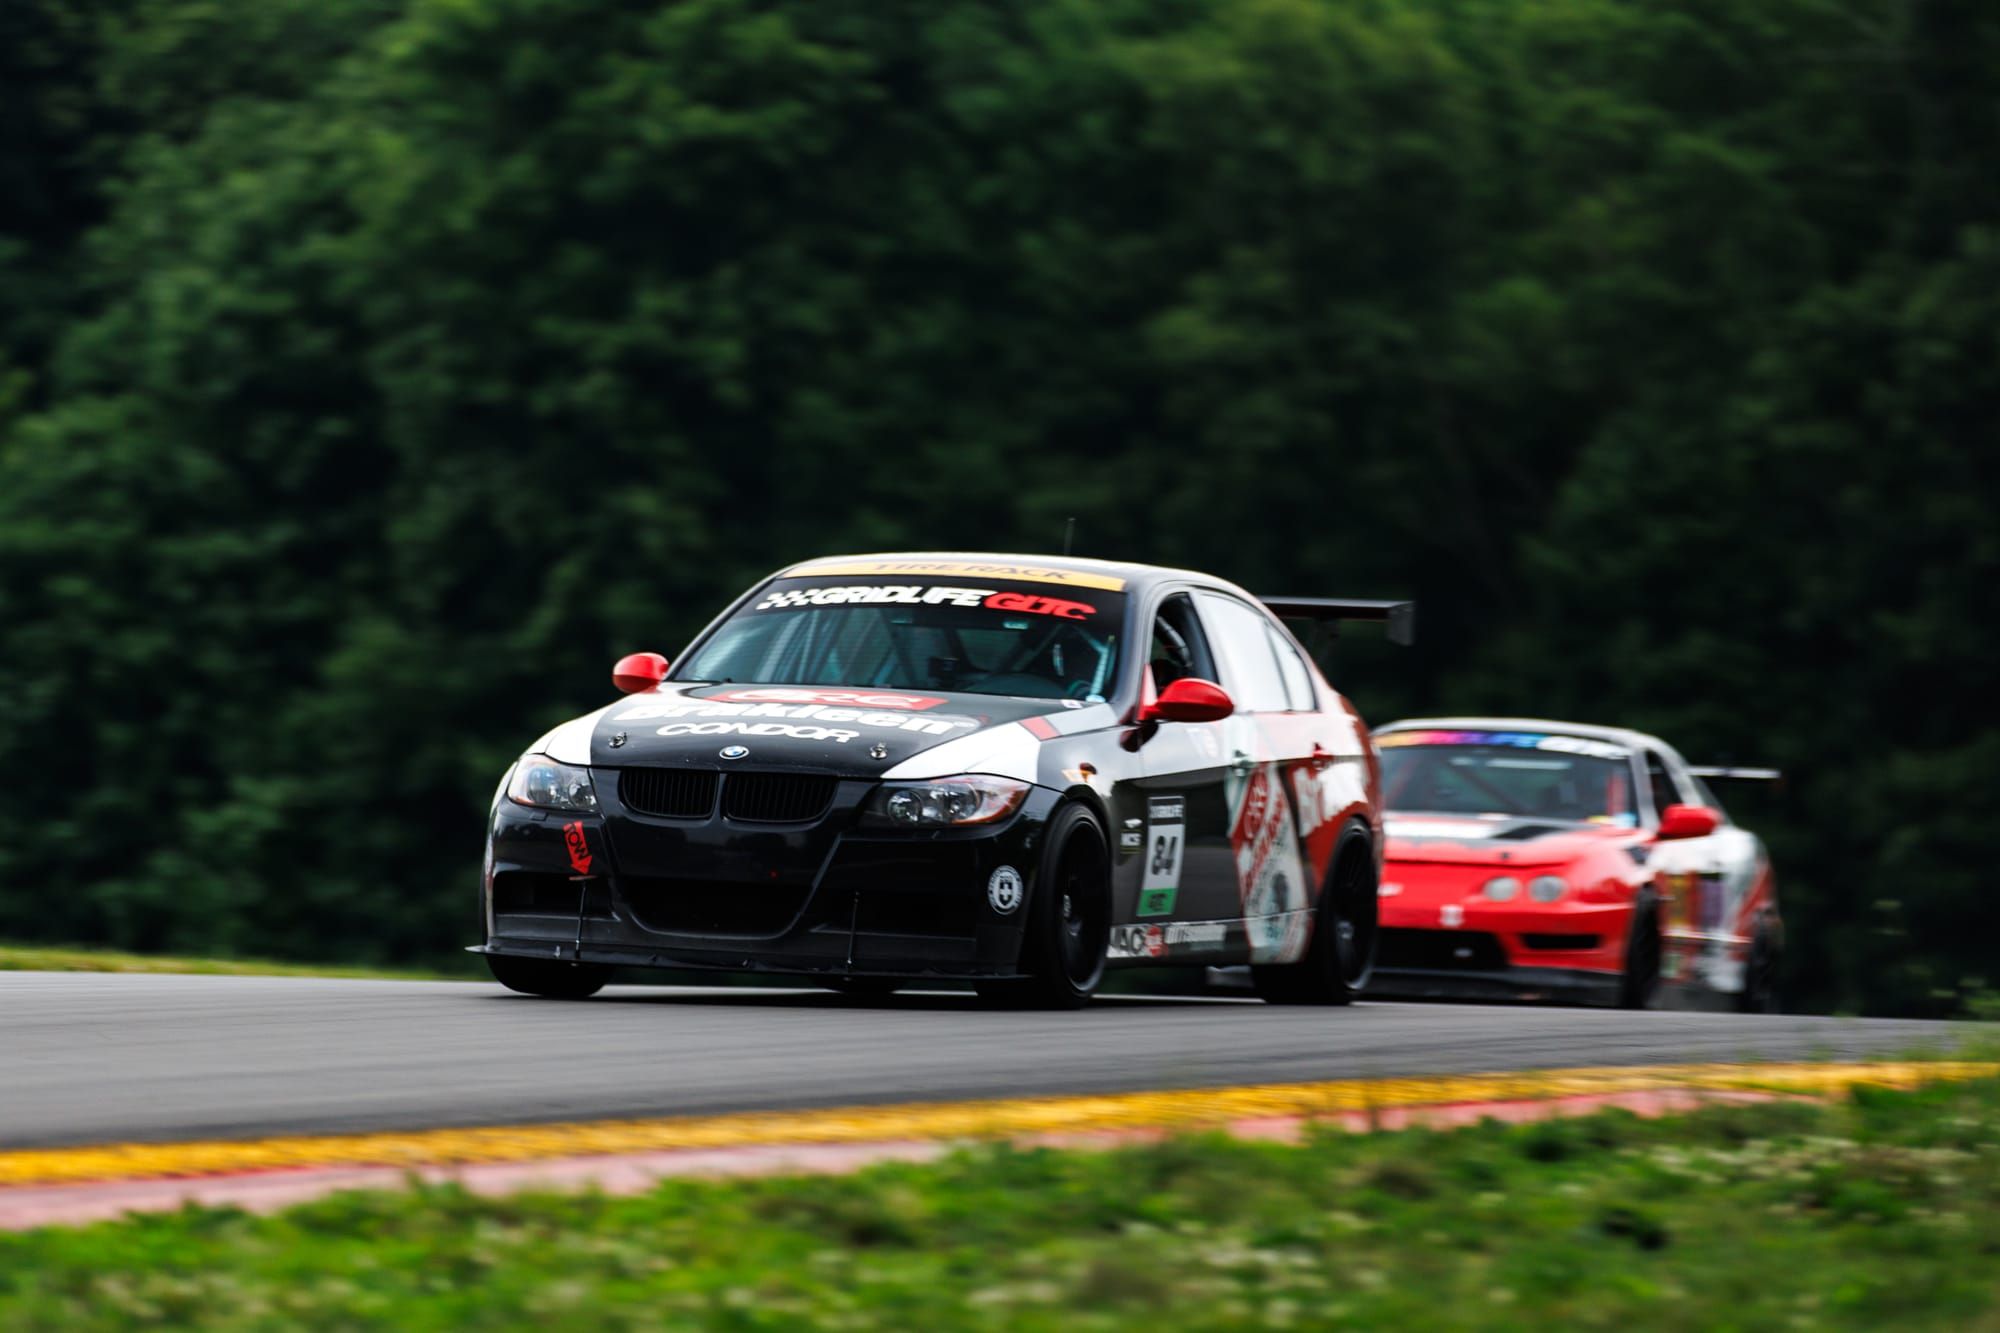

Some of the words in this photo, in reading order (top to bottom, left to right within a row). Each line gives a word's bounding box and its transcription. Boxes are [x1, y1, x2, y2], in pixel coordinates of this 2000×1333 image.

[875, 563, 954, 571] TIRE
[964, 565, 1073, 580] RACK
[811, 585, 998, 607] GRIDLIFE
[983, 591, 1097, 620] GLTC
[656, 722, 862, 743] CONDOR
[564, 823, 588, 860] TOW
[1151, 835, 1179, 875] 84
